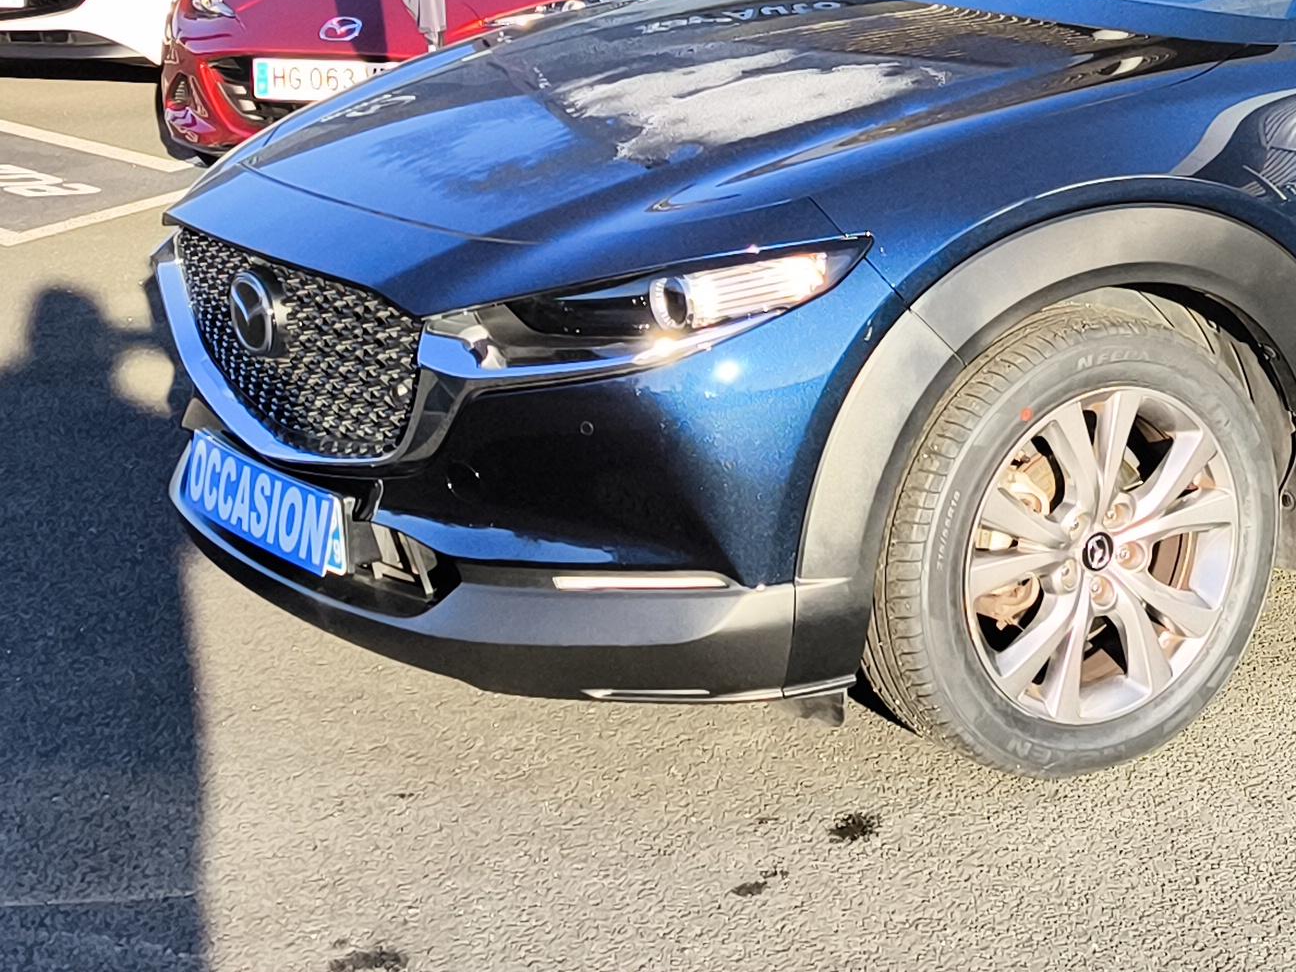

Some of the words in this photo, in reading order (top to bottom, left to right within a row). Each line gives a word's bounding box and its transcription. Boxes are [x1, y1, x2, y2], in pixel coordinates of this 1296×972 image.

[273, 67, 302, 90] HG
[310, 67, 356, 91] 063
[190, 439, 329, 556] OCCASION
